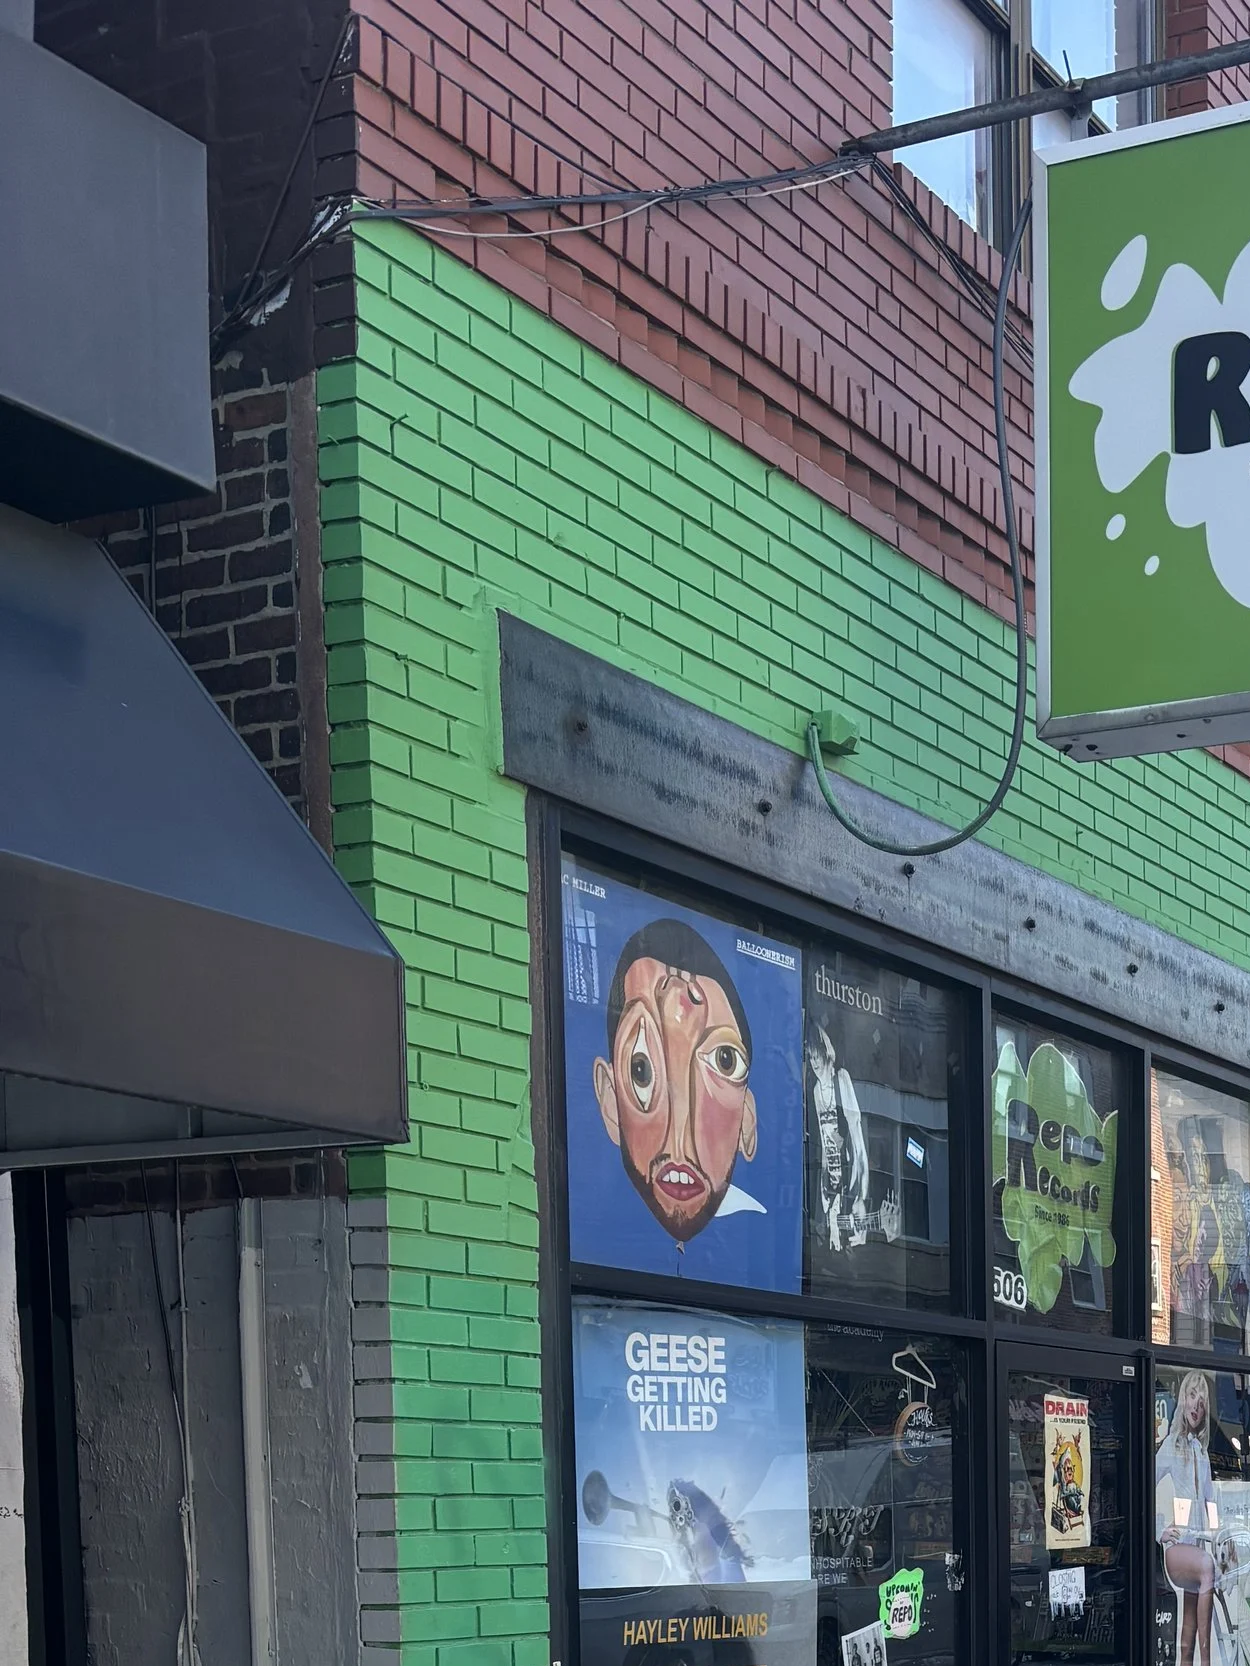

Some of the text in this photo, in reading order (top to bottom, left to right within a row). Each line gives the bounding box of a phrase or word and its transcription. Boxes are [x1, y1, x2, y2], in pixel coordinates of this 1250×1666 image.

[572, 877, 606, 899] MILLER
[815, 964, 883, 1016] thurston
[1006, 1098, 1104, 1182] Repo
[625, 1332, 726, 1373] GEESE
[627, 1375, 726, 1403] GETTING
[639, 1405, 717, 1431] KILLED
[1045, 1400, 1087, 1417] DRAIN
[892, 1604, 913, 1624] REPO
[623, 1612, 768, 1645] HAYLEY WILLIAMS
